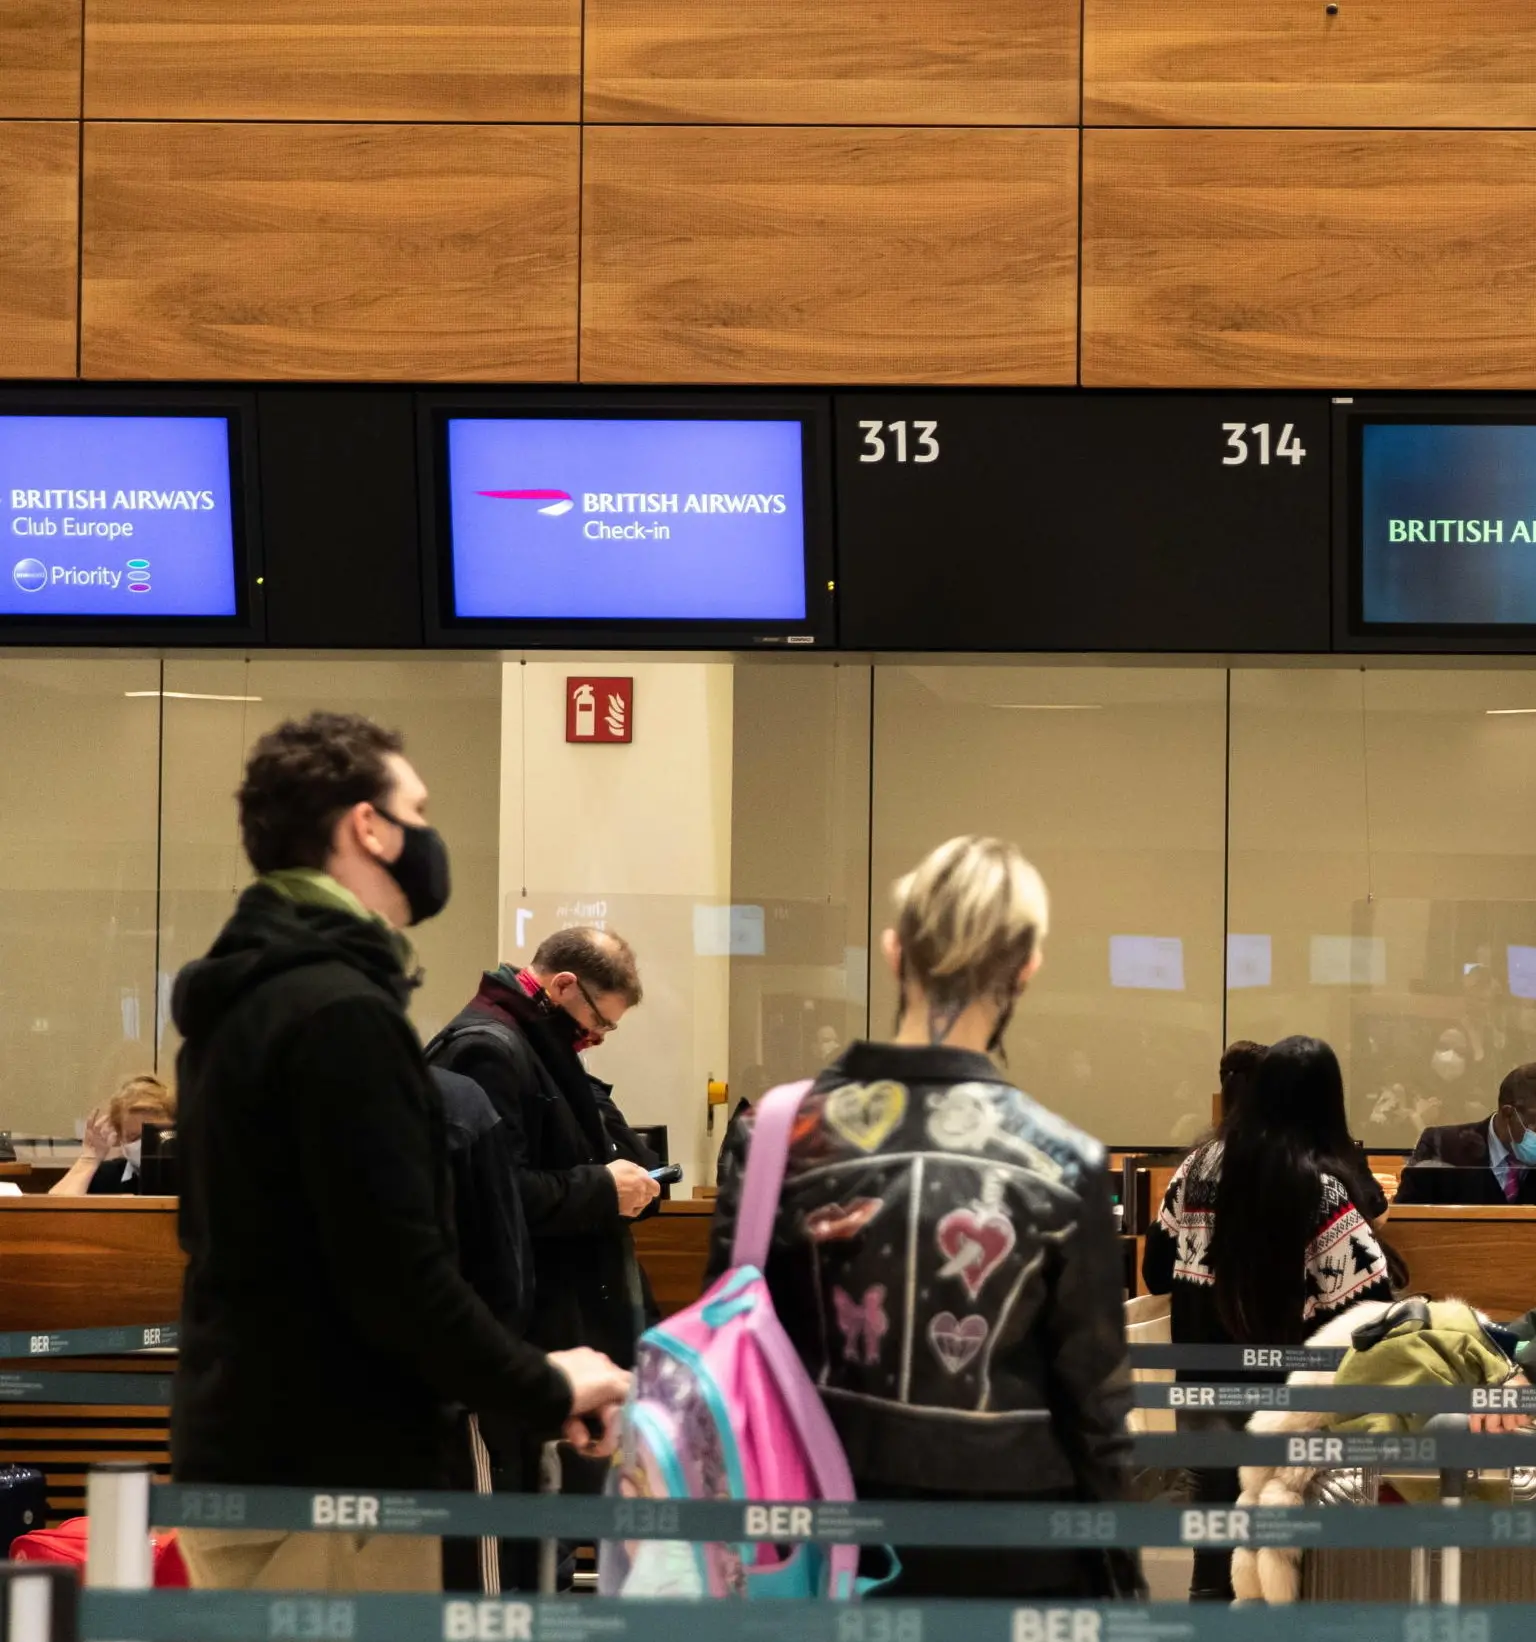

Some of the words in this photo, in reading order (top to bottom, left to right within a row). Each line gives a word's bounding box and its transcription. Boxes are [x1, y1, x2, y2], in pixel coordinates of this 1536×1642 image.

[858, 421, 941, 463] 313
[1221, 423, 1306, 466] 314
[11, 489, 106, 509] BRITISH
[112, 490, 214, 510] AIRWAYS
[583, 493, 678, 513] BRITISH
[684, 494, 786, 513] AIRWAYS
[12, 517, 57, 535] Club
[64, 518, 133, 540] Europe
[583, 520, 671, 540] Check-in
[1388, 519, 1503, 544] BRITISH
[52, 566, 122, 588] Priority
[31, 1335, 49, 1352] BER
[144, 1328, 160, 1344] BER
[1243, 1349, 1282, 1366] BER
[1170, 1387, 1215, 1405] BER
[1472, 1388, 1518, 1408] BER
[1288, 1437, 1343, 1461] BER
[312, 1495, 378, 1525] BER
[746, 1505, 812, 1535] BER
[1180, 1510, 1249, 1540] BER
[444, 1602, 532, 1640] BER
[1013, 1608, 1101, 1642] BER
